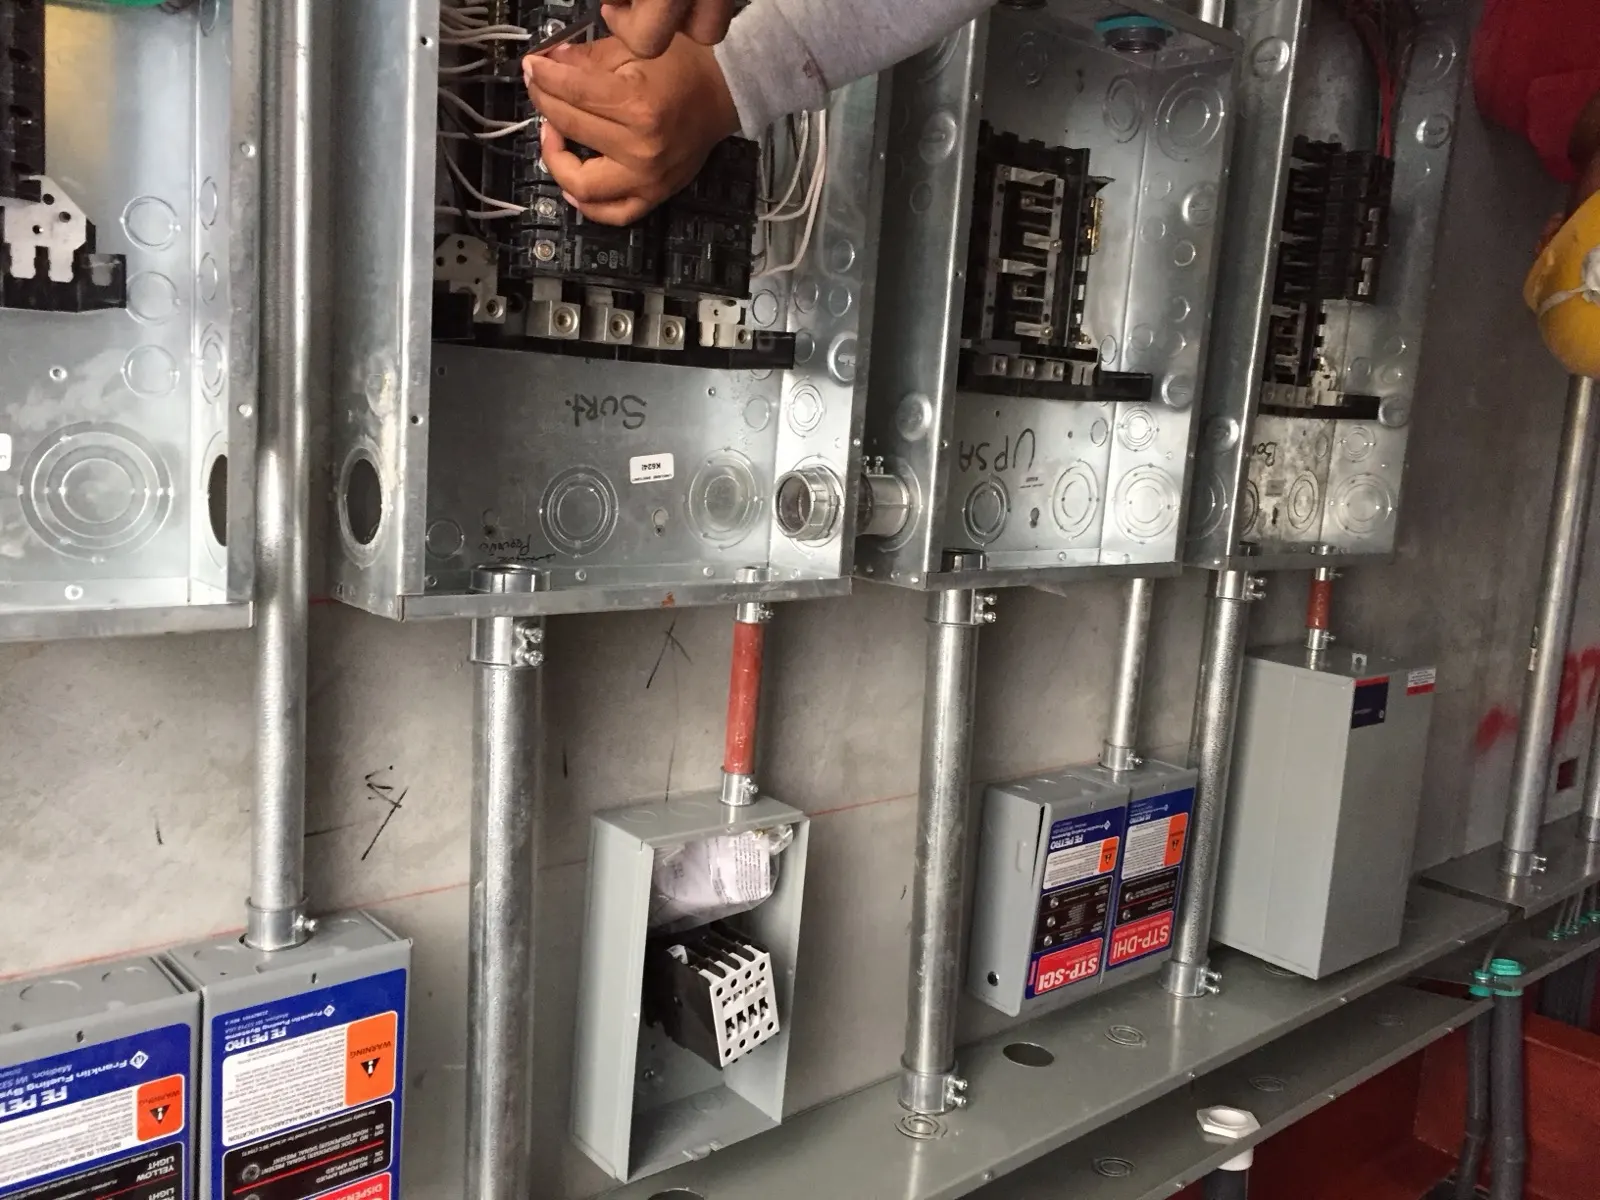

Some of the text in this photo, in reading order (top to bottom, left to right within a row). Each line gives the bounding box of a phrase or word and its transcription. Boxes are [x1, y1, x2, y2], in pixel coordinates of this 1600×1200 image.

[959, 428, 1035, 472] UPSA
[1050, 836, 1073, 849] PETRO
[1112, 925, 1168, 959] STP-DHI
[1037, 957, 1097, 990] STP-SCI
[291, 1009, 322, 1023] Franklin
[224, 1026, 260, 1041] Systems
[224, 1026, 285, 1052] FE PETRO
[349, 1040, 390, 1058] WARNING
[31, 1064, 72, 1079] Madison,
[75, 1058, 127, 1080] Franklin
[15, 1074, 27, 1085] WI
[26, 1071, 73, 1093] Fueling
[40, 1086, 67, 1105] FE
[138, 1090, 179, 1105] WARNING
[322, 1101, 343, 1113] INSTALL
[375, 1122, 383, 1130] ON
[228, 1129, 258, 1142] LOCATION
[359, 1133, 368, 1141] NO
[298, 1144, 317, 1156] SIGNAL
[147, 1154, 174, 1170] LIGHT
[272, 1152, 296, 1165] PRESENT
[285, 1155, 306, 1166] SIGNAL
[348, 1154, 368, 1167] POWER
[359, 1160, 367, 1168] NO
[135, 1163, 174, 1182] YELLOW
[261, 1162, 284, 1175] PRESENT
[325, 1161, 347, 1174] APPLIED
[338, 1163, 358, 1176] POWER
[316, 1171, 337, 1183] APPLIED
[148, 1186, 174, 1200] LIGHT
